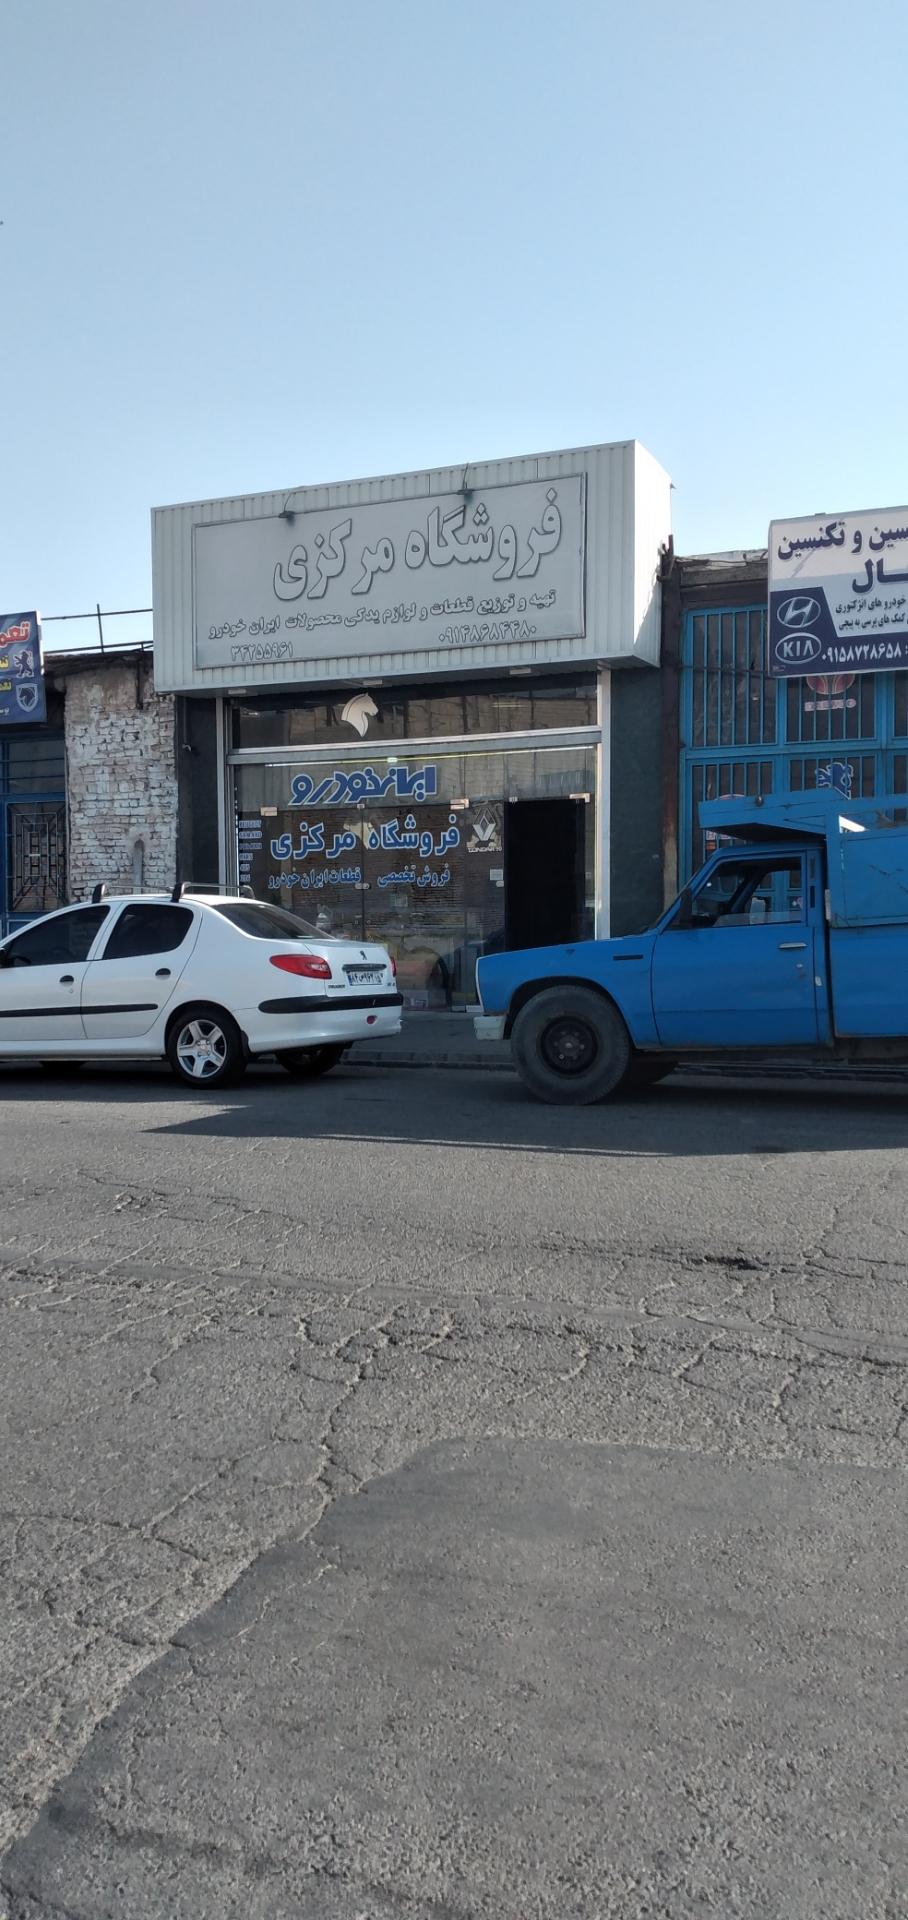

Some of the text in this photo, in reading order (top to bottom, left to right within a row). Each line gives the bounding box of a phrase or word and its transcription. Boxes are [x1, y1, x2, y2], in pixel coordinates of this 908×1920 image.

[273, 487, 562, 600] فروشگاه مرکزی
[778, 521, 908, 561] سین و تکنسین
[852, 558, 908, 594] ال
[208, 589, 556, 639] تهیه و توزیع قطعات و لوازم یدکی محصولات ایران خودرو
[783, 640, 814, 658] KIA
[270, 814, 461, 860] فروشگاه مرکزی
[268, 866, 362, 889] قطعات ایران خودرو
[377, 863, 451, 887] فروش تخصصی
